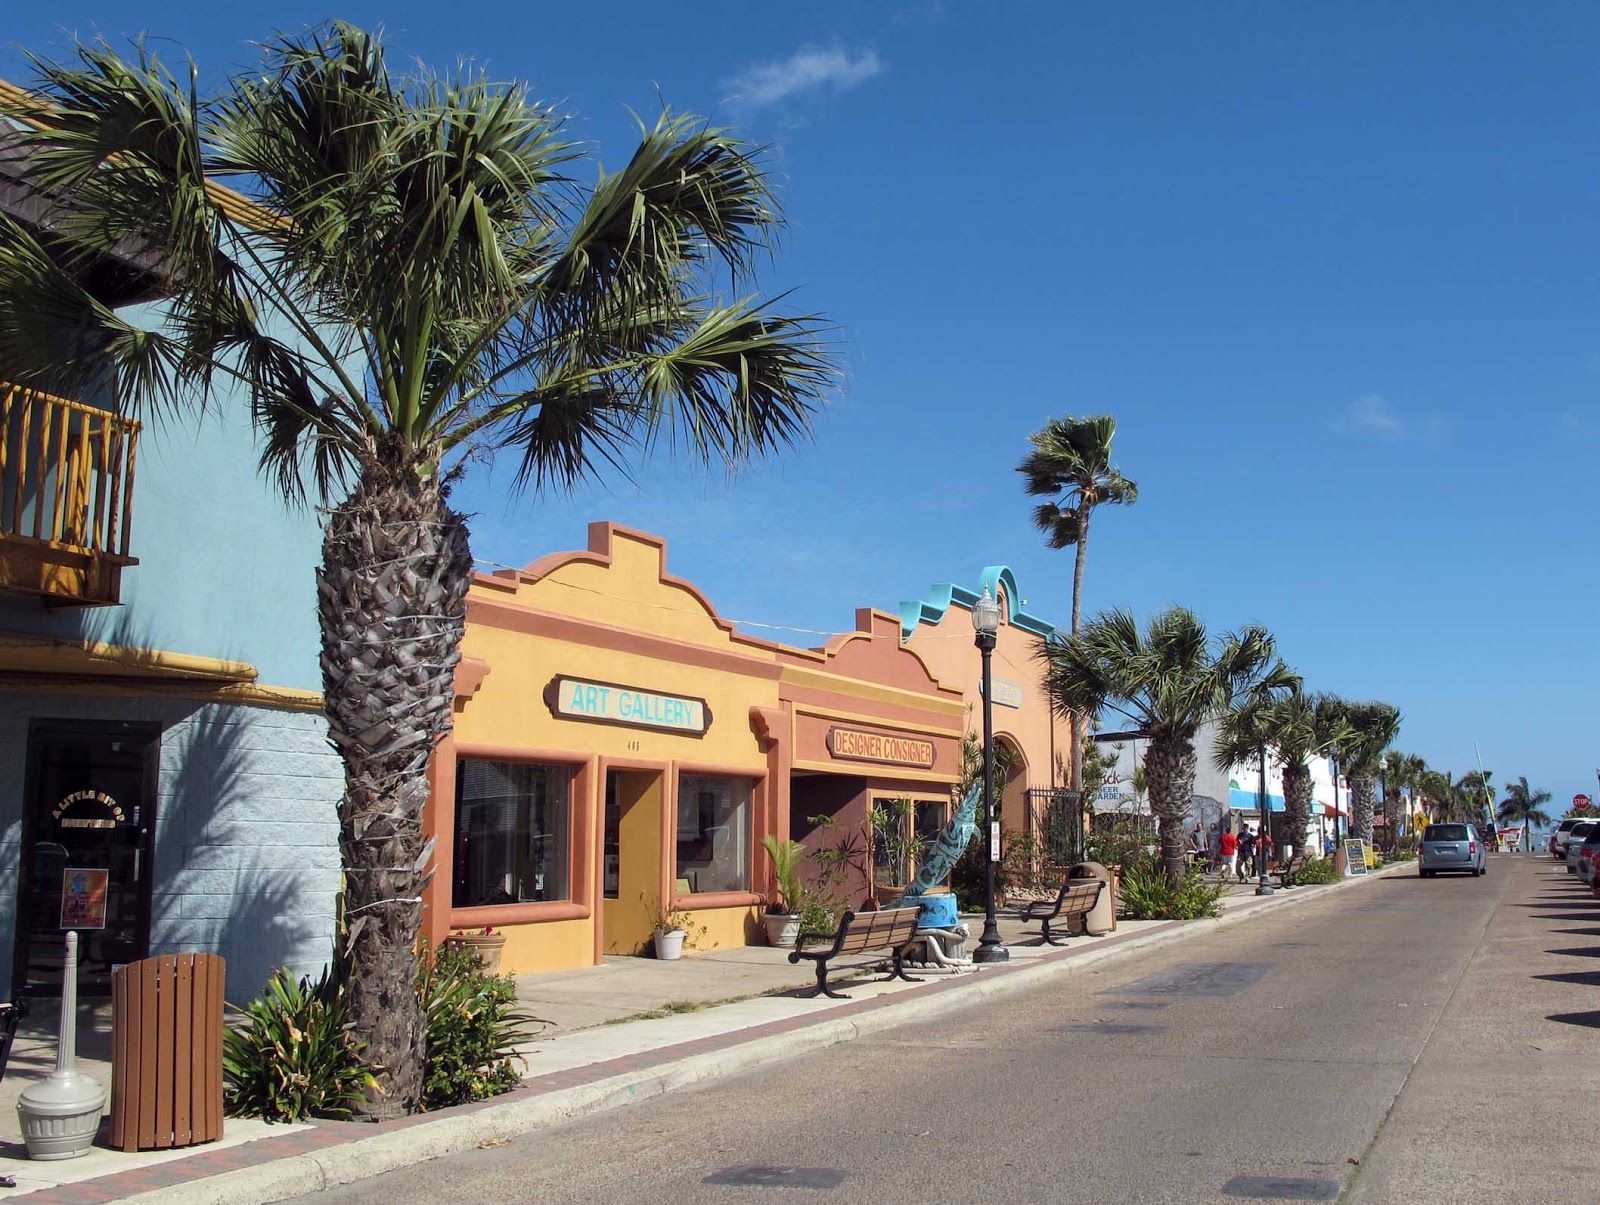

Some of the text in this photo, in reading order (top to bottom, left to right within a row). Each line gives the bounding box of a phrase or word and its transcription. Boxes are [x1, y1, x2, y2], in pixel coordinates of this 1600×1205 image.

[570, 684, 696, 726] ART GALLERY
[835, 731, 931, 763] DESIGNER CONSIGNER
[52, 790, 126, 821] A LITTLE BIT OF
[1574, 798, 1589, 806] STOP
